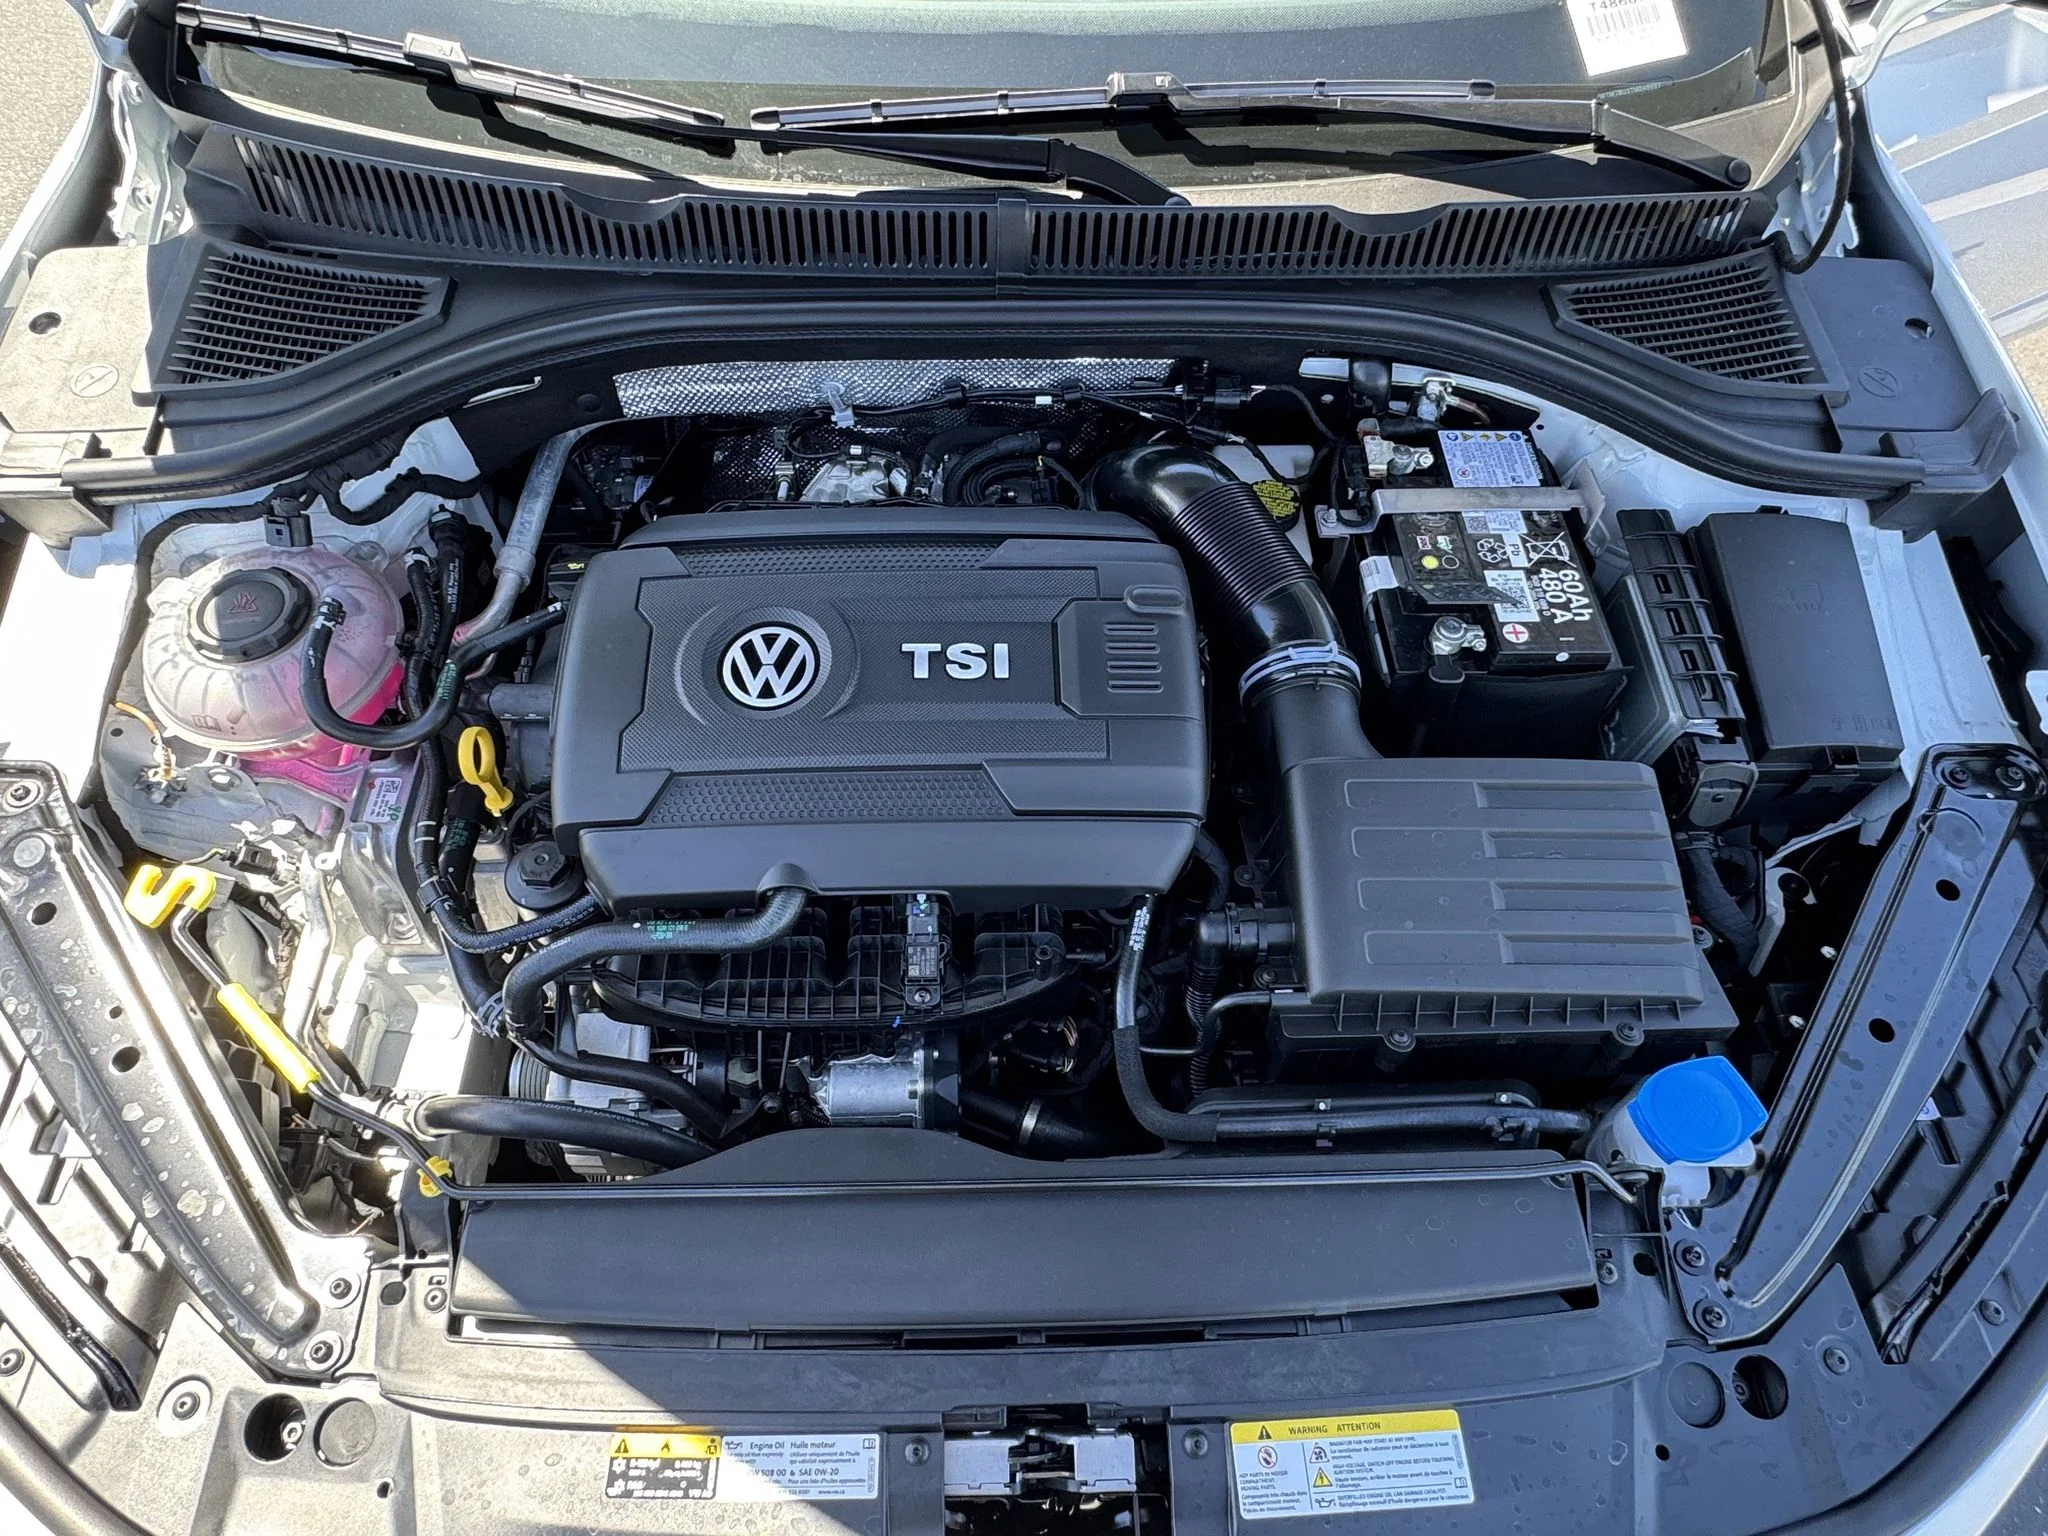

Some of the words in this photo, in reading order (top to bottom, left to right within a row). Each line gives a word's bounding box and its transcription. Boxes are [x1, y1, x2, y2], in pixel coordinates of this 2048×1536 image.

[1508, 543, 1521, 557] Pb
[1538, 567, 1568, 603] 480
[1558, 569, 1594, 621] 60Ah
[1550, 607, 1574, 624] A
[722, 626, 816, 707] VW
[901, 641, 1010, 680] TSI
[1288, 1425, 1328, 1435] WARNING
[1336, 1421, 1381, 1433] ATTENTION
[750, 1442, 773, 1451] Engine
[774, 1441, 785, 1450] Oil
[790, 1441, 808, 1449] Huile
[814, 1468, 839, 1476] 0W-20
